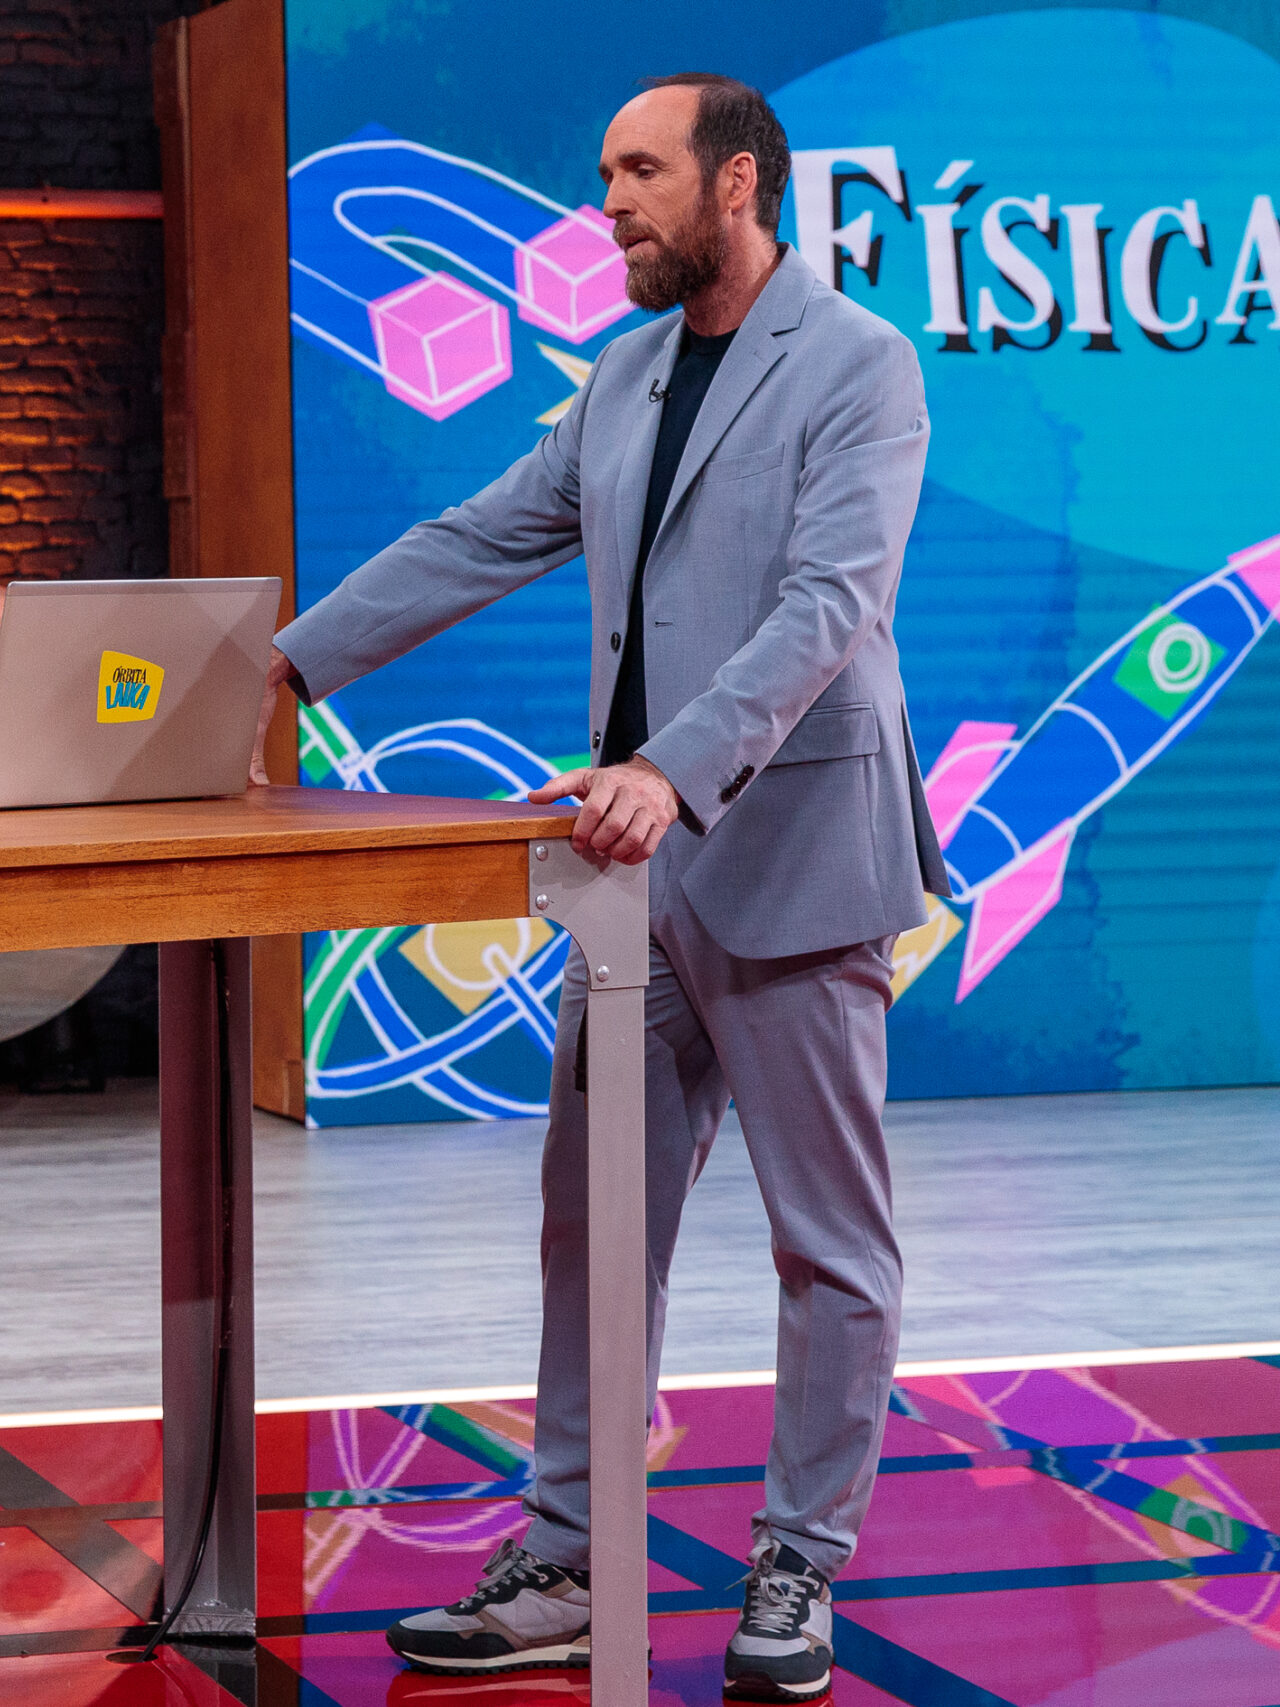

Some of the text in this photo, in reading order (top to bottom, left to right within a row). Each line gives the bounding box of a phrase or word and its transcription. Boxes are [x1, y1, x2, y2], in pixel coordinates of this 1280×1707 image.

[791, 146, 1280, 338] FÍSICA
[112, 666, 147, 684] ÓRBITA
[105, 681, 151, 710] LAIKA
